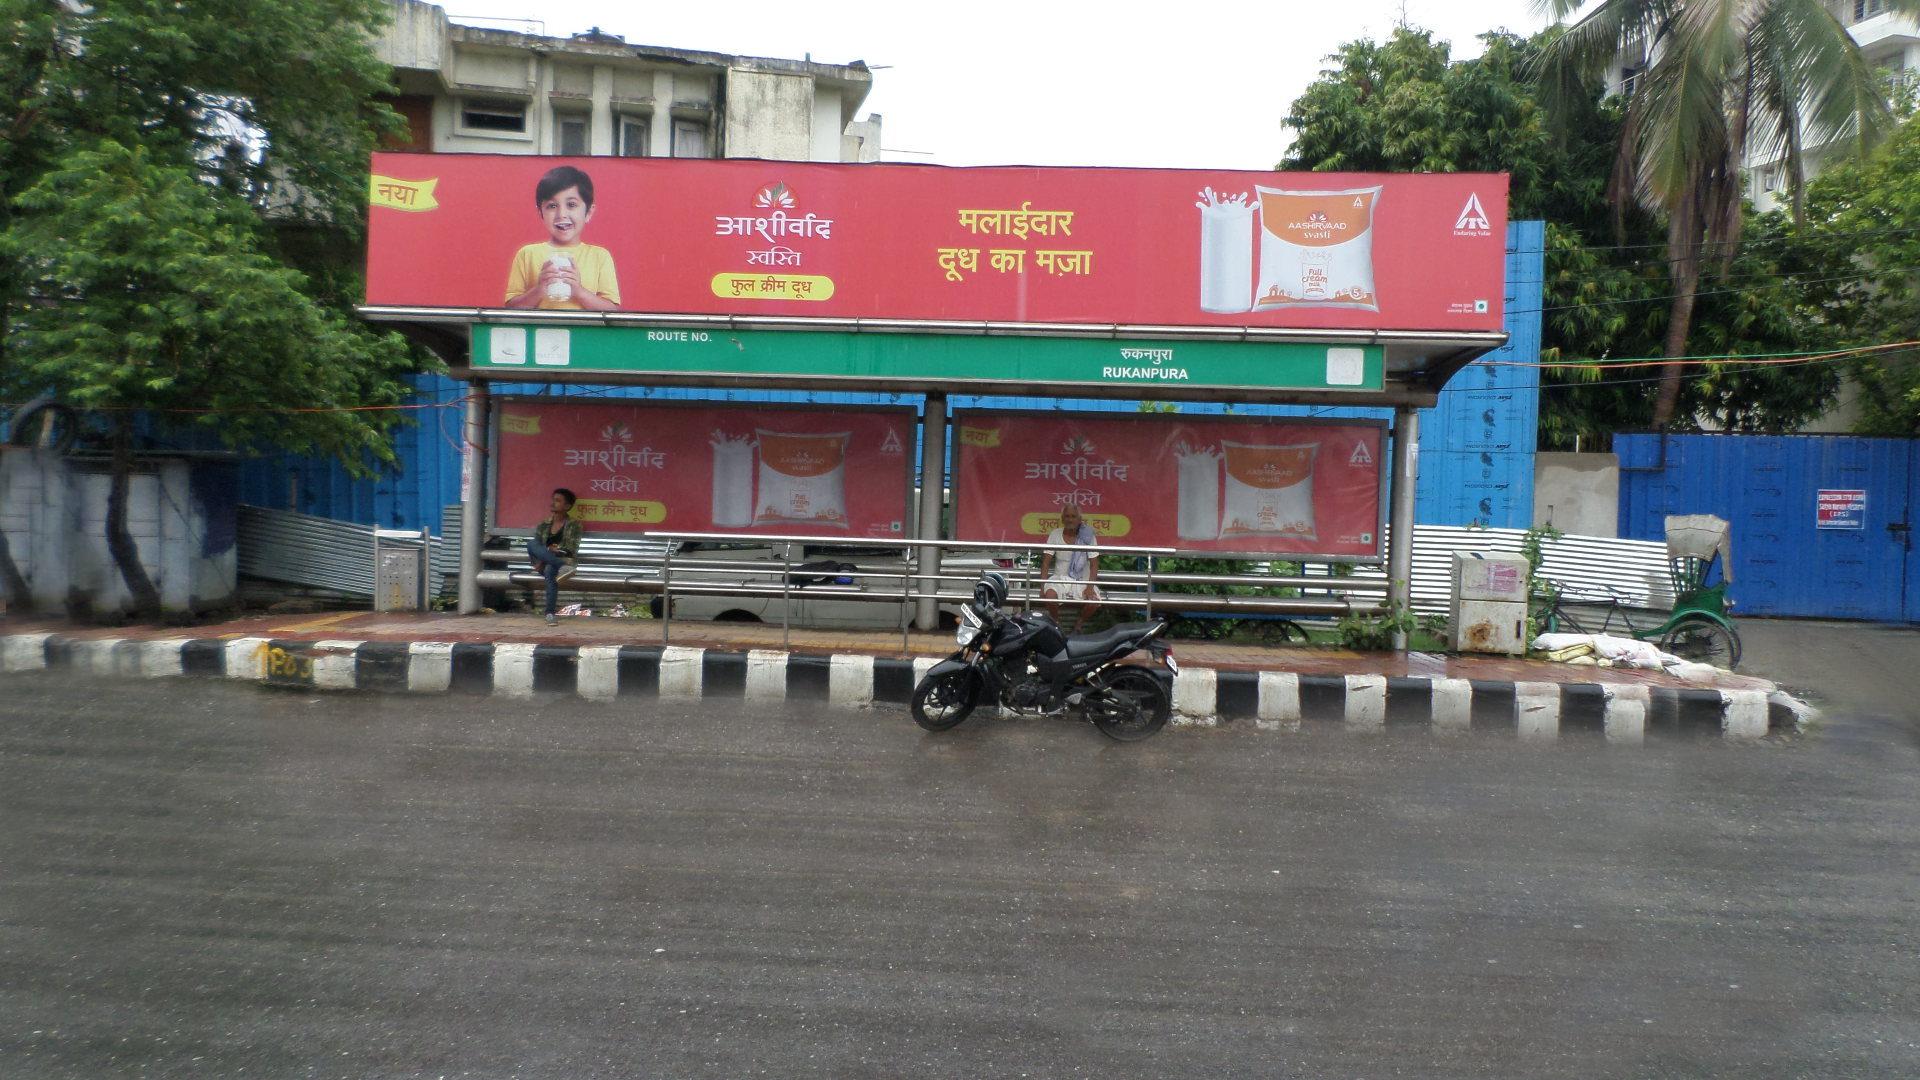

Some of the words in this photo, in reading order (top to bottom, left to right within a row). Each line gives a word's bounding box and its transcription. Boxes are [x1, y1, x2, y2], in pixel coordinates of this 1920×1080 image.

[378, 184, 418, 205] नया
[715, 210, 834, 243] आशीर्वाद
[958, 201, 1074, 240] मलाईदार
[1288, 222, 1347, 230] AASHIRVAAD
[746, 245, 802, 266] स्वस्ति
[937, 248, 981, 282] दूध
[989, 249, 1027, 274] का
[1035, 250, 1093, 277] मज़ा
[1308, 268, 1323, 276] Full
[731, 279, 755, 297] फुल
[760, 275, 786, 293] क्रीम
[791, 280, 812, 299] दूध
[1302, 275, 1327, 284] cream
[648, 331, 688, 342] ROUTE
[691, 332, 713, 342] NO.
[1120, 347, 1173, 365] रुकनपुरा
[1103, 366, 1189, 380] RUKANPURA
[507, 417, 530, 430] नया
[965, 430, 990, 444] नया
[563, 444, 668, 472] आशीर्वाद
[1024, 457, 1130, 486] आशीर्वाद
[591, 475, 639, 493] स्वस्ति
[1052, 488, 1101, 507] स्वस्ति
[576, 503, 598, 519] फुल
[602, 501, 626, 517] क्रीम
[630, 505, 648, 521] दूध
[1038, 518, 1059, 532] फुल
